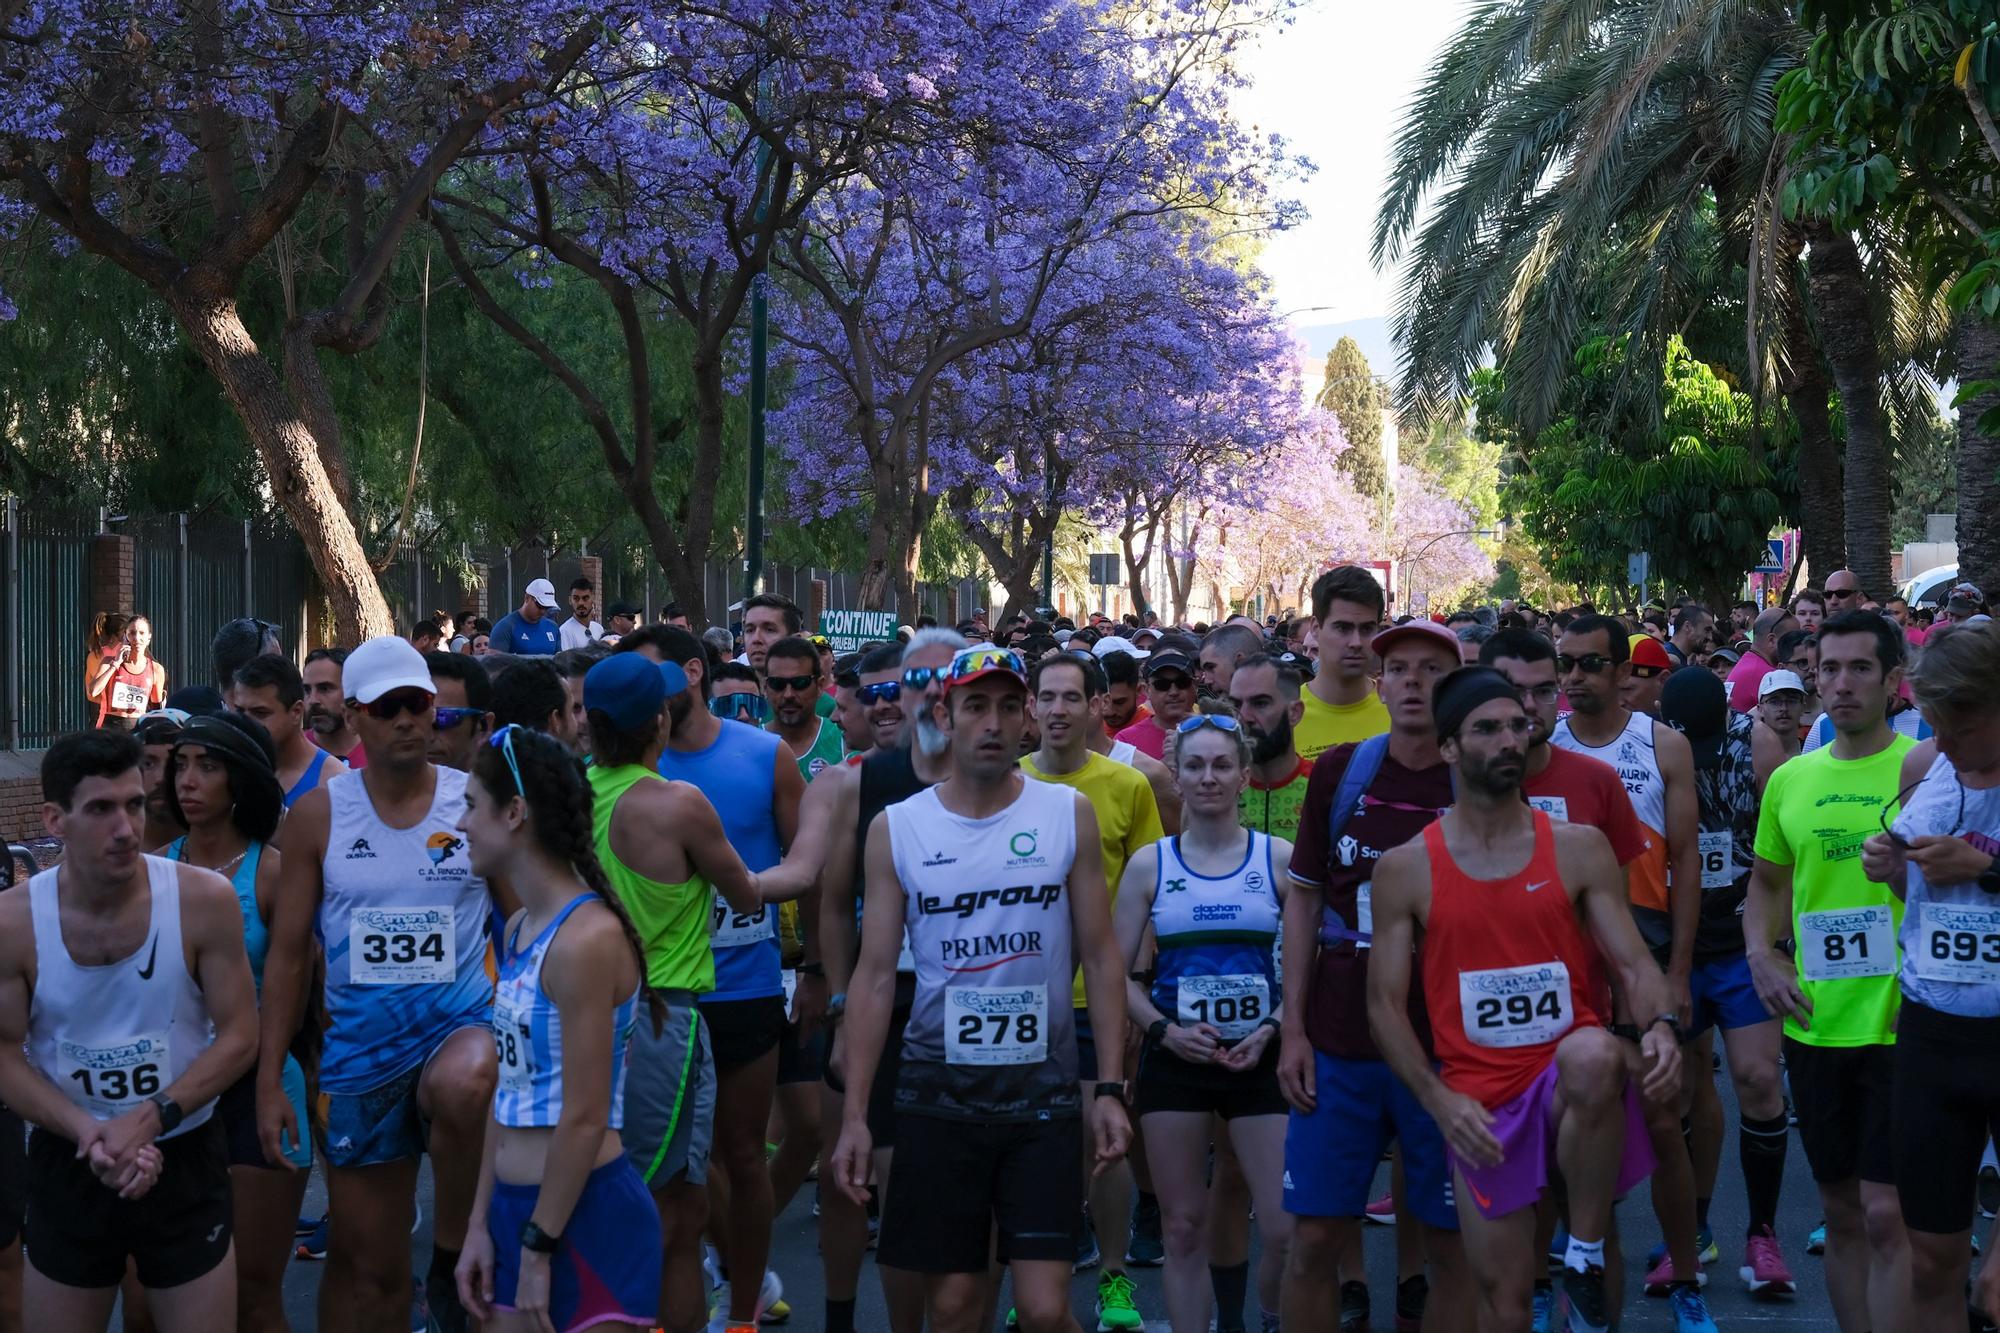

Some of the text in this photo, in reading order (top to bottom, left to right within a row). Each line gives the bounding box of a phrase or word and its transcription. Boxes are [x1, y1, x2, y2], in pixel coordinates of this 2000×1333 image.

[821, 610, 897, 636] "CONTINUE"
[831, 636, 857, 651] PRUEBA
[117, 692, 144, 704] 299
[437, 867, 468, 876] RINCÓN
[1192, 904, 1242, 915] clapham
[1192, 912, 1236, 921] chasers
[363, 933, 445, 963] 334
[941, 931, 1042, 961] PRIMOR
[1824, 932, 1868, 961] 81
[1931, 930, 2000, 963] 693
[1190, 995, 1260, 1023] 108
[1476, 990, 1562, 1029] 294
[958, 1014, 1038, 1044] 278
[71, 1063, 160, 1100] 136
